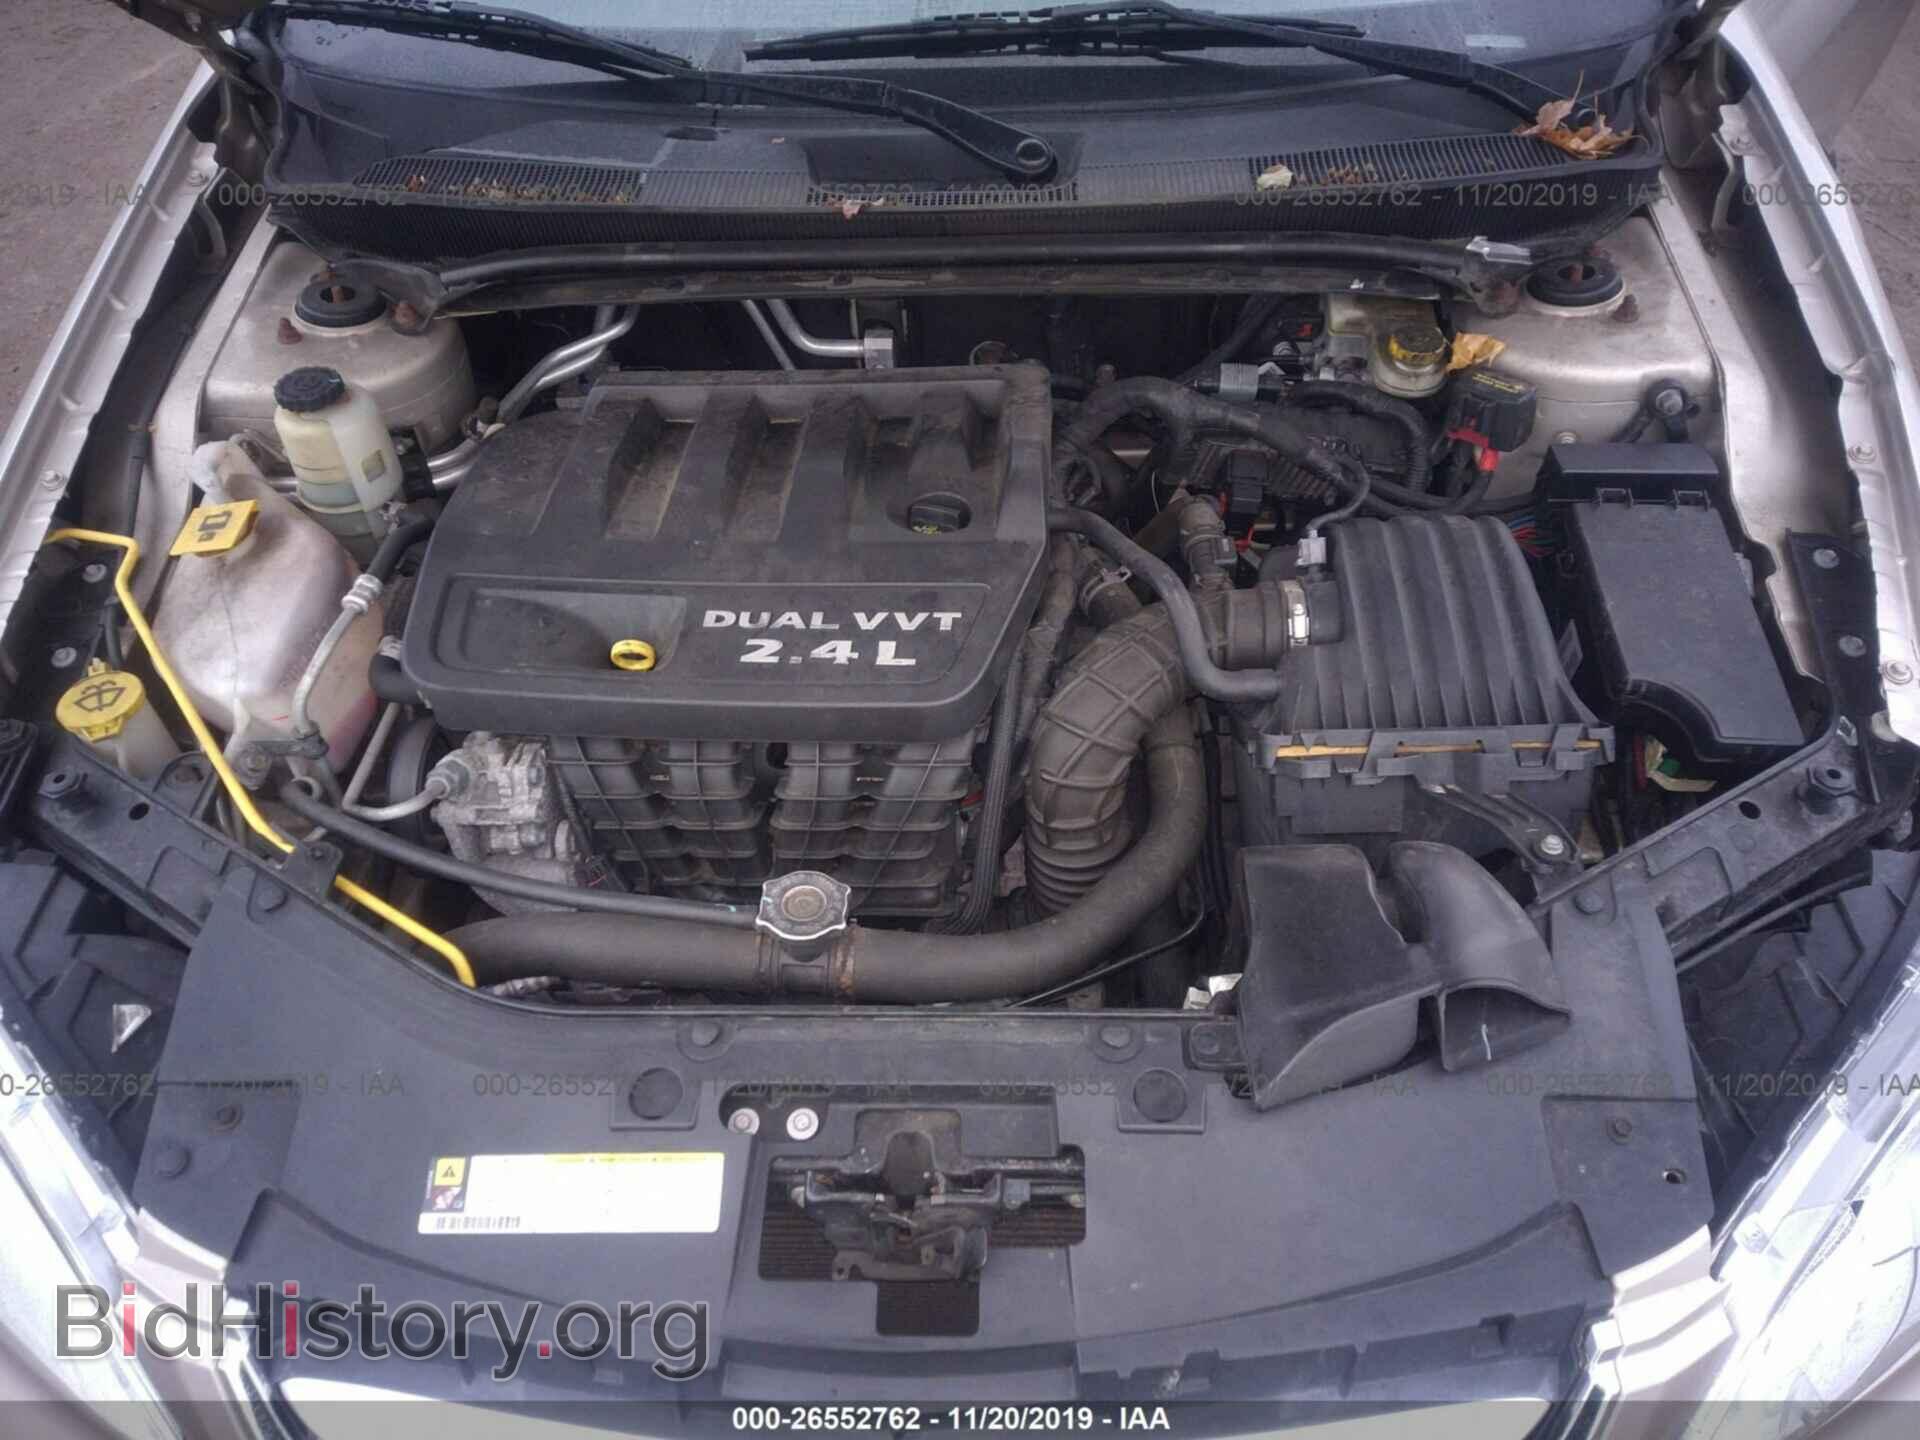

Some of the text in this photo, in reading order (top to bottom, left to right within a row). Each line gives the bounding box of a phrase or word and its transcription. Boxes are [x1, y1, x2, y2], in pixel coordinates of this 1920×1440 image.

[702, 609, 962, 631] DUAL VVT
[739, 638, 917, 666] 2.4 L
